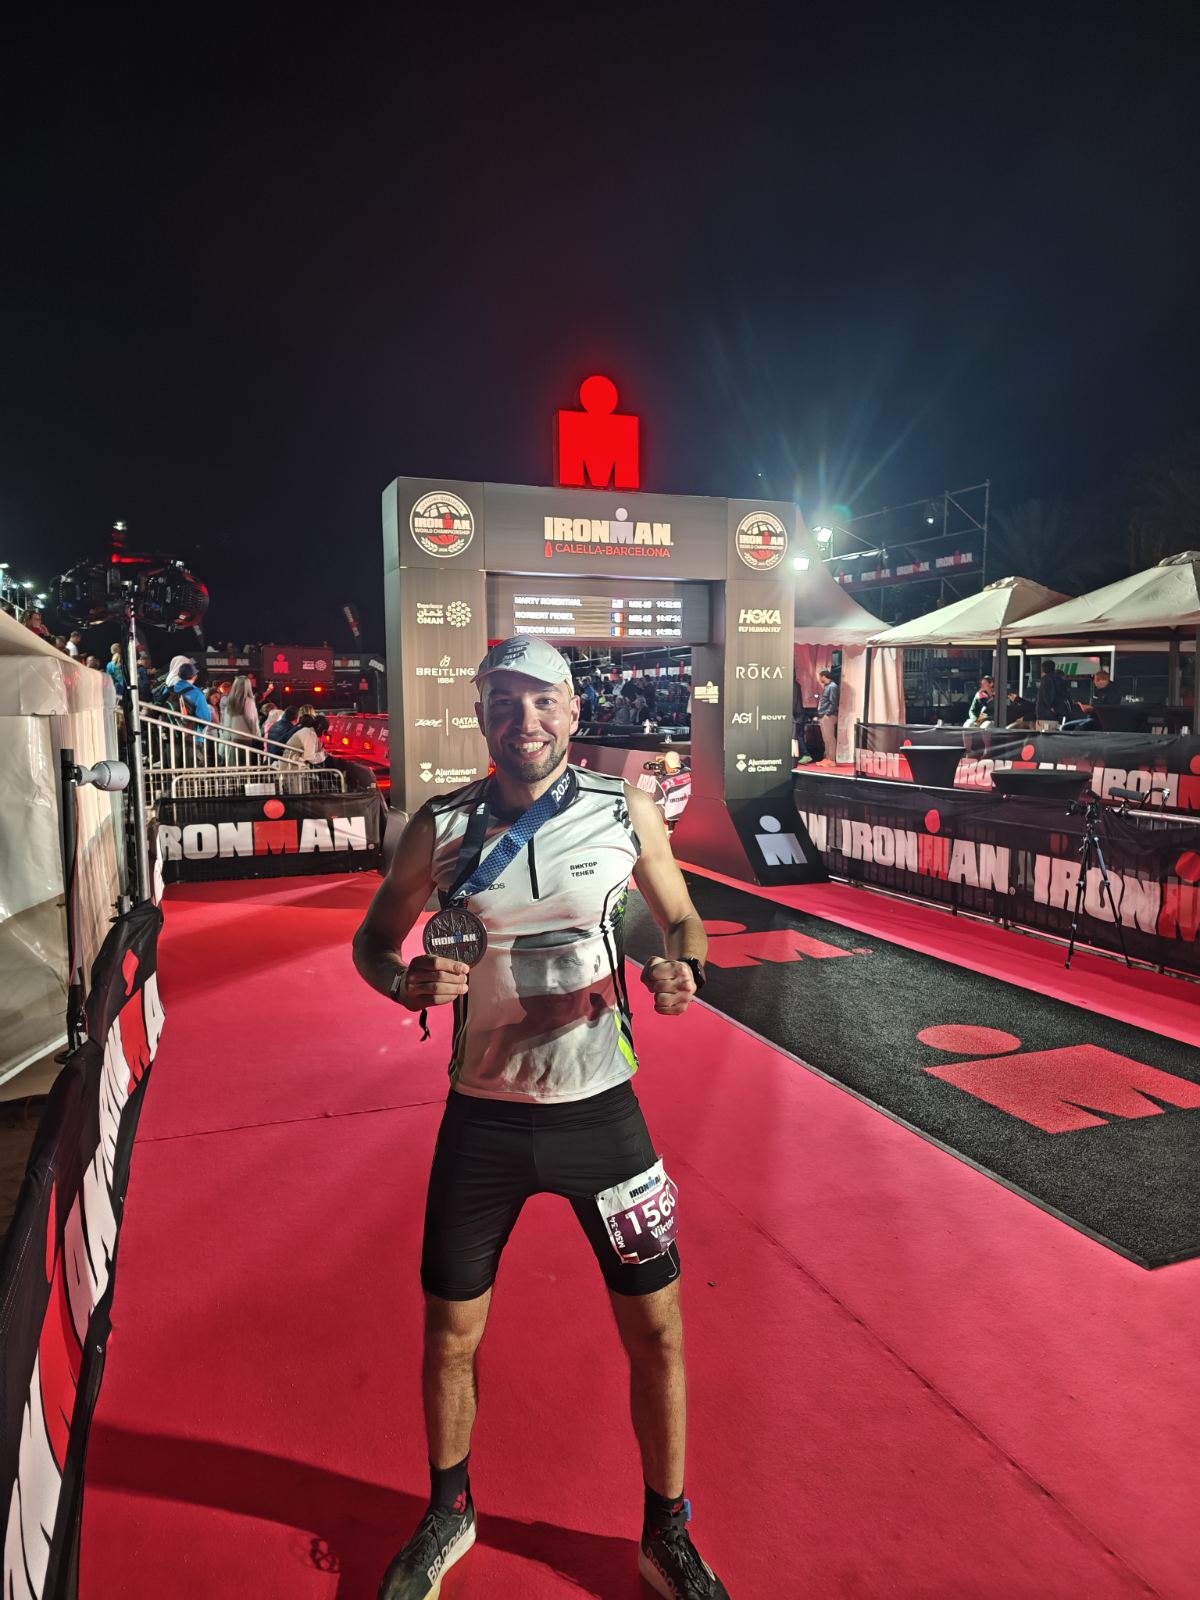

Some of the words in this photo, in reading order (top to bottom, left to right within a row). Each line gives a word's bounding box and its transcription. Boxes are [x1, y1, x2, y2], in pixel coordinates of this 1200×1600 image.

[414, 512, 471, 530] IRONMAN
[544, 507, 672, 546] IRONMAN
[739, 531, 784, 546] IRONMAN
[555, 543, 671, 558] CALELLA-BARCELONA
[416, 617, 444, 625] OMAN
[738, 609, 781, 625] HOKA
[415, 667, 476, 677] BREITLING
[451, 717, 479, 727] QATAR
[731, 712, 753, 724] AG1
[748, 759, 782, 767] Ajuntament
[434, 768, 477, 778] Ajuntament
[445, 776, 471, 784] Calella
[157, 798, 368, 861] RONMAN
[842, 809, 1010, 895] IRONMAN
[570, 861, 598, 870] ВИКТОР
[571, 869, 595, 878] ТЕНЕВ
[431, 930, 477, 946] IRONMAN
[651, 1216, 674, 1239] Viktor
